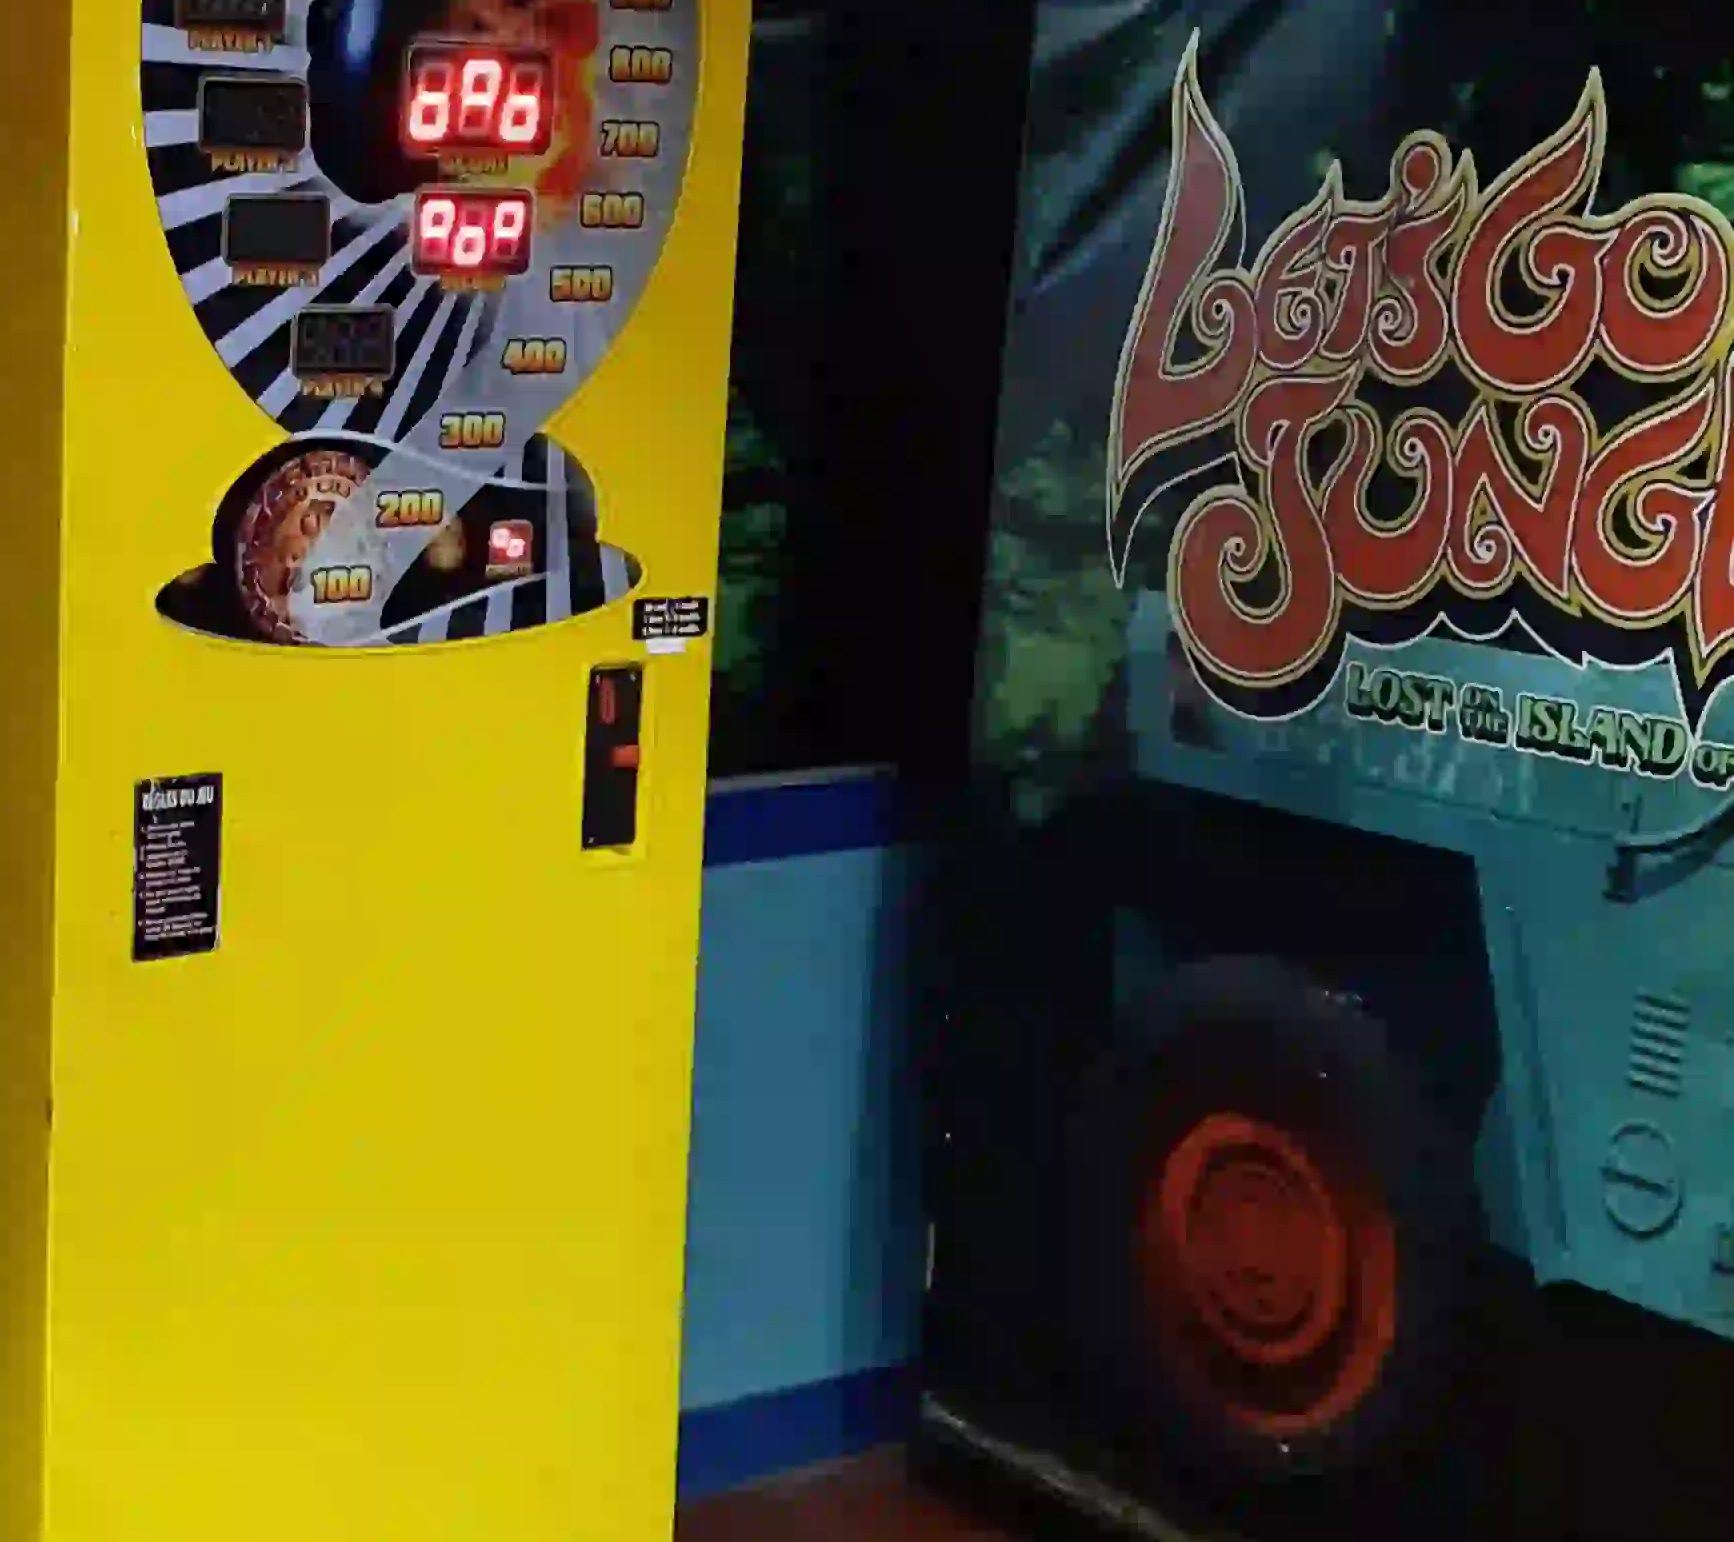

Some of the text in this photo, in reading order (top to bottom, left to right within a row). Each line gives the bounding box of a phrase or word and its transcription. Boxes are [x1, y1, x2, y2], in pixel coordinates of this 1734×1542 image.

[600, 120, 660, 157] 700
[580, 191, 644, 228] 600
[1450, 66, 1734, 401] GO
[550, 264, 612, 302] 500
[502, 329, 566, 374] 400
[440, 412, 506, 449] 300
[375, 488, 444, 528] 200
[311, 564, 373, 604] 100
[1345, 661, 1456, 733] LOST
[1515, 693, 1689, 778] ISLAND
